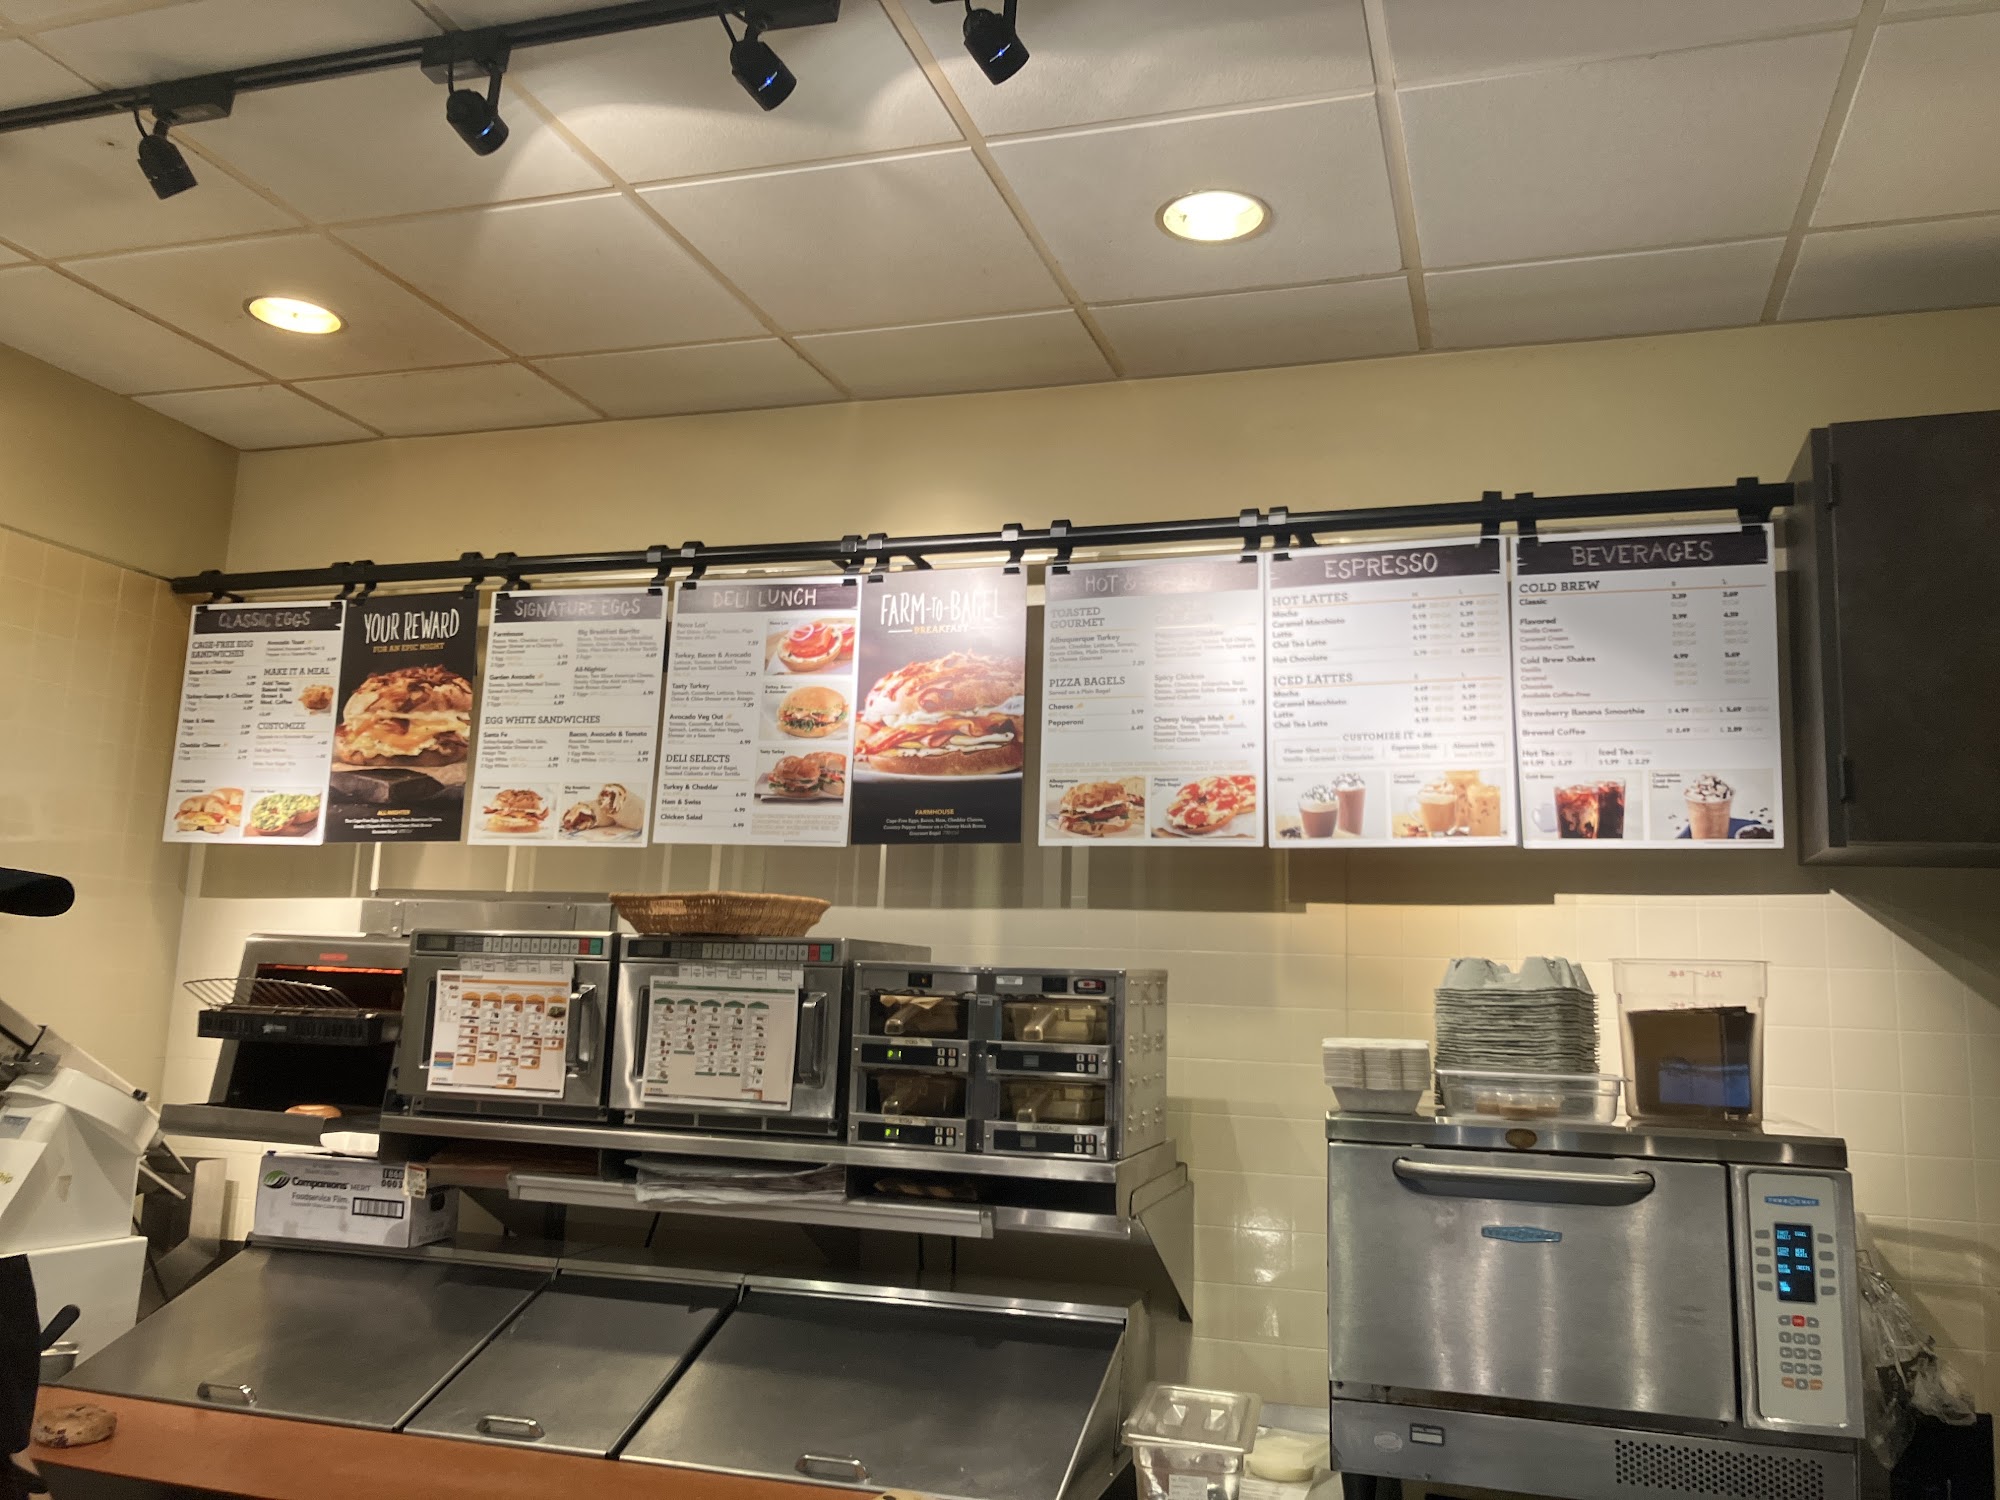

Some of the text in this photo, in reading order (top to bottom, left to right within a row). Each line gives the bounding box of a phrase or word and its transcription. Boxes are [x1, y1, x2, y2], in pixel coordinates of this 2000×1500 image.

[1571, 540, 1714, 566] BEVERAGES
[1324, 552, 1438, 579] ESPRESSO
[1085, 575, 1119, 592] HOT
[1519, 580, 1600, 593] COLD BREW
[712, 588, 817, 608] DELI LUNCH
[1272, 592, 1348, 606] HOT LATTES
[514, 598, 640, 618] SIGNATURE EGGS
[1051, 607, 1101, 618] TOASTED
[218, 611, 311, 628] CLASSIC EGGS
[1050, 618, 1105, 629] GOURMET
[364, 608, 460, 644] YOUR REWARD
[913, 624, 968, 634] BREAKFAST
[1097, 634, 1120, 642] Turkey
[1520, 656, 1540, 664] Cold
[1050, 676, 1125, 688] PIZZA BAGELS
[1273, 673, 1353, 686] ICED LATTES
[1522, 709, 1569, 718] Strawberry
[1571, 708, 1602, 716] Banana
[485, 715, 600, 725] EGG WHITE SANDWICHES
[1048, 719, 1084, 727] Pepperoni
[1343, 732, 1401, 742] CUSTOMIZE
[1403, 732, 1415, 740] IT
[666, 754, 730, 763] DELI SELECTS
[914, 808, 954, 816] FARMHOUSE
[291, 1176, 348, 1190] Companions
